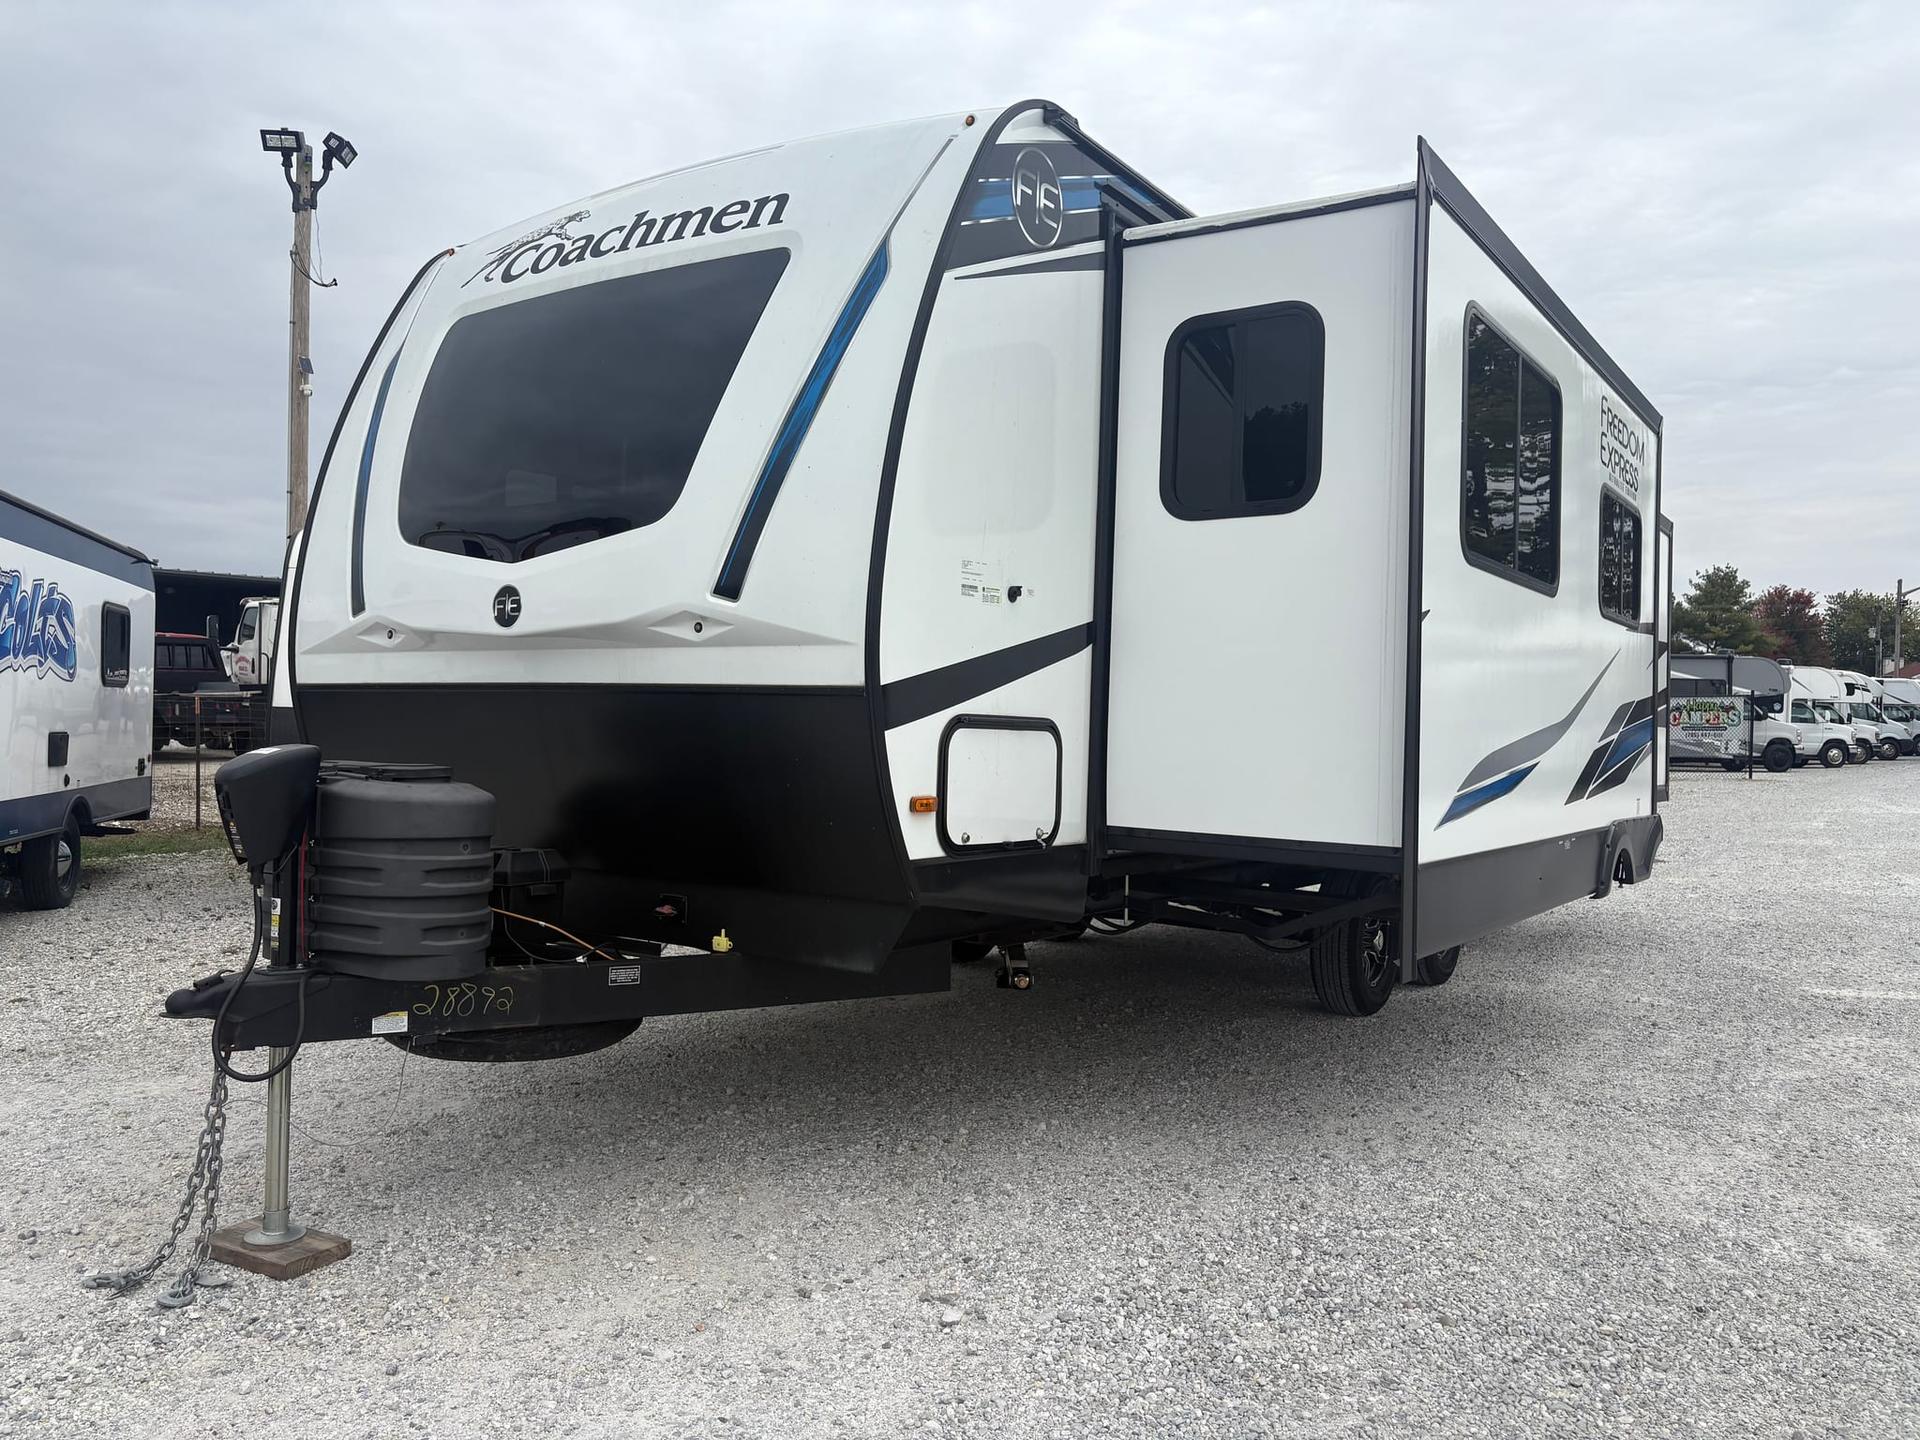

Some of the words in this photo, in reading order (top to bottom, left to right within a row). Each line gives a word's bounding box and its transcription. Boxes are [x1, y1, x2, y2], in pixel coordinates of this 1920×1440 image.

[500, 193, 790, 283] Coachmen
[1600, 395, 1645, 466] FREEDOM
[1600, 431, 1639, 492] EXPRESS
[1670, 709, 1741, 727] CAMPERS
[412, 983, 514, 1016] 28892
